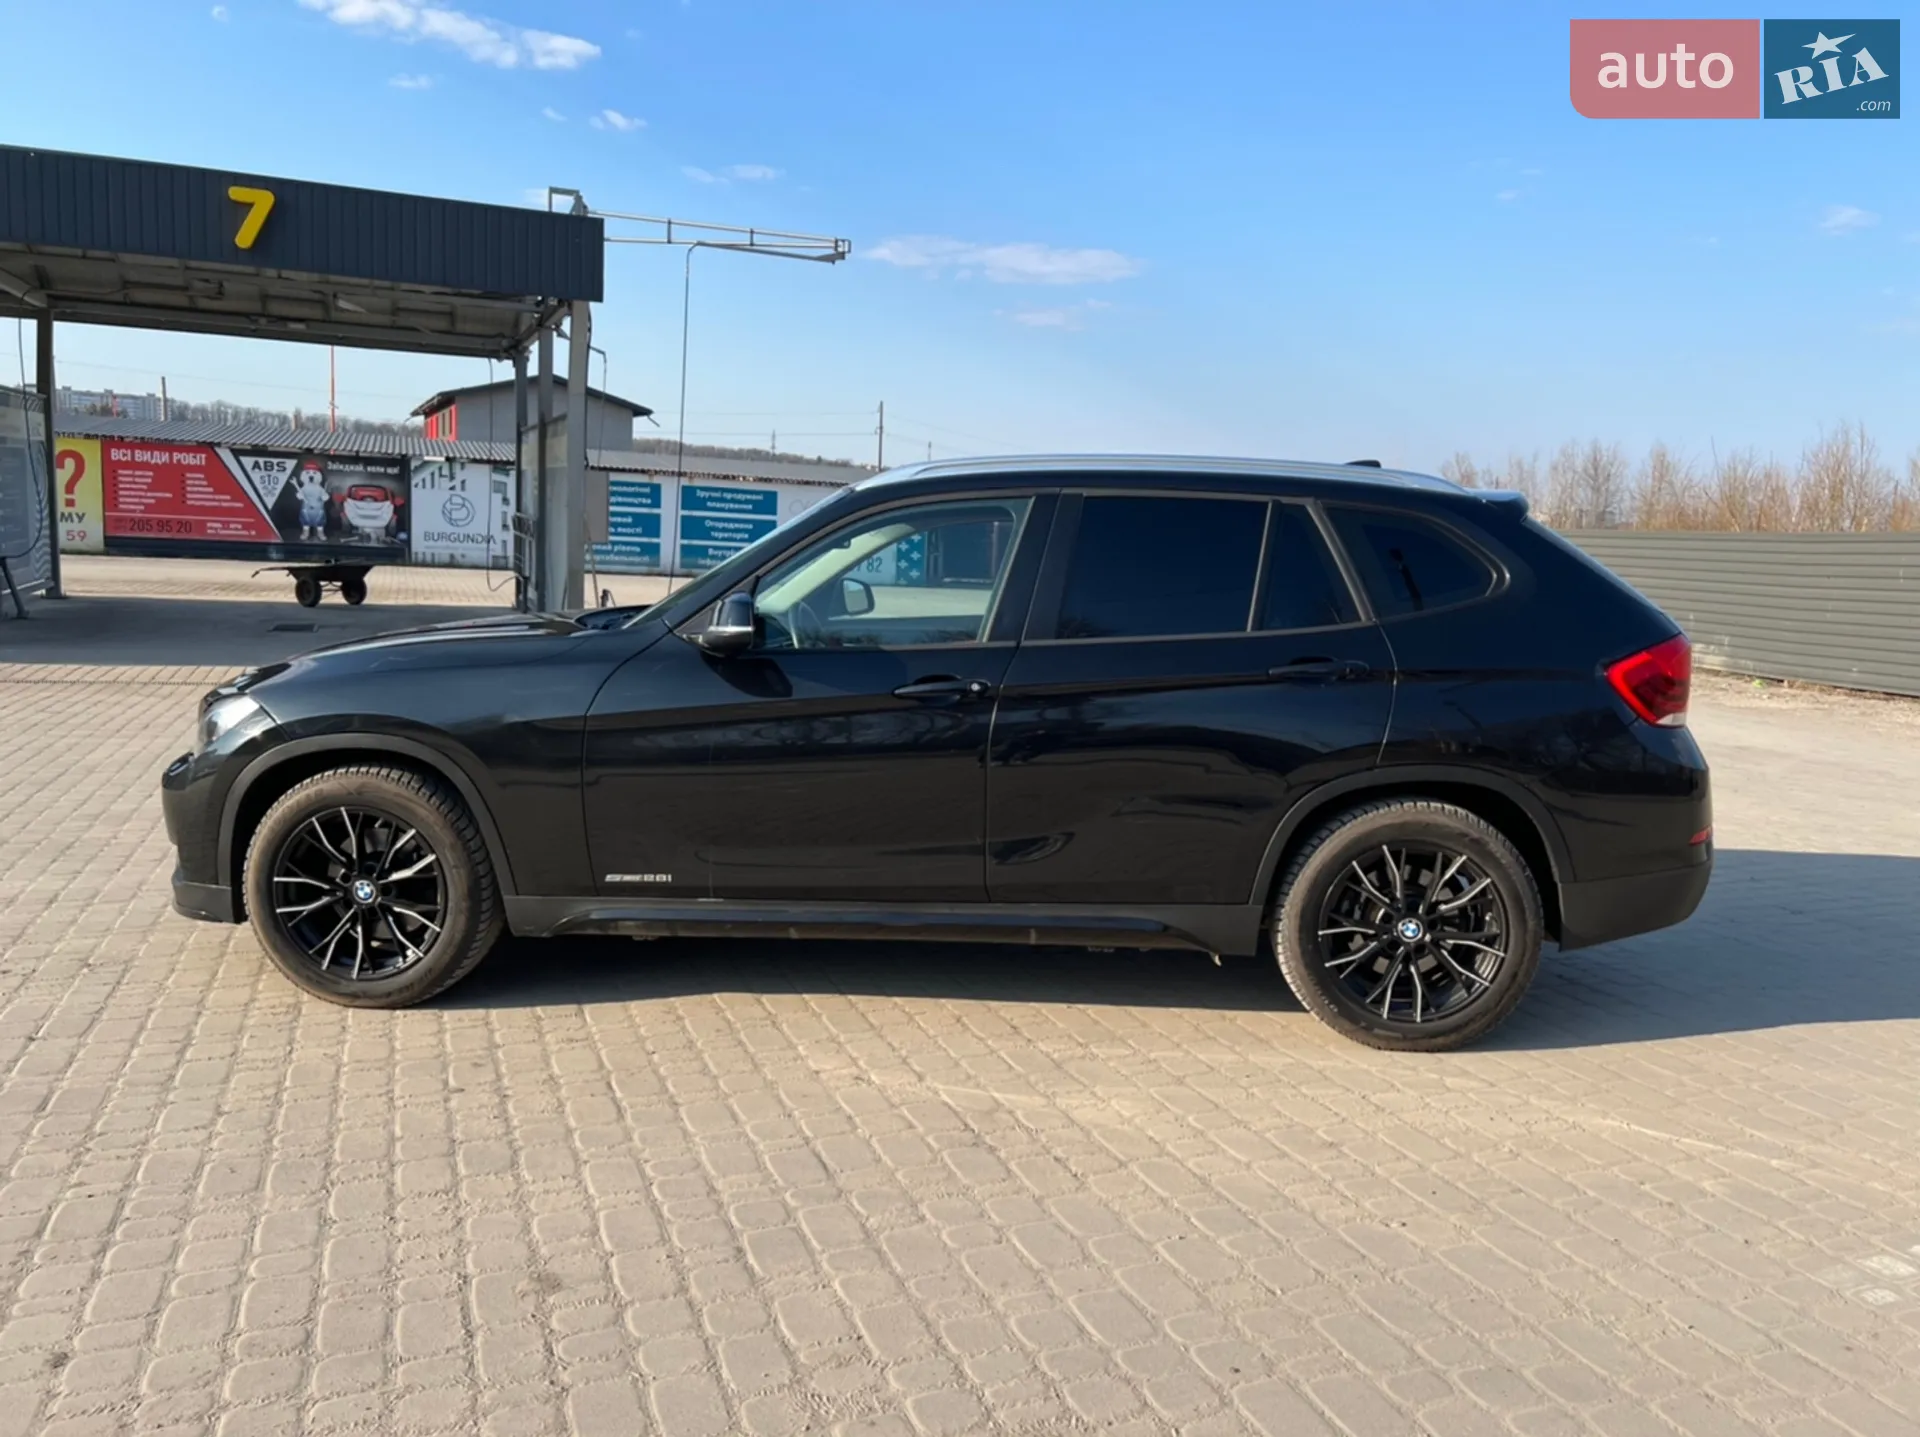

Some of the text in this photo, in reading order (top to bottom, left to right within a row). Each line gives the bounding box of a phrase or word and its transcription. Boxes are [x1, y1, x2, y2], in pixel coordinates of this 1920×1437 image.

[227, 185, 276, 250] 7
[110, 447, 207, 466] ВСІ ВИДИ РОБІТ
[251, 459, 288, 473] ABS
[706, 500, 753, 511] планування
[129, 518, 154, 533] 205
[156, 519, 172, 534] 95
[176, 520, 192, 534] 20
[65, 530, 87, 542] 59
[423, 530, 498, 546] BURGUNDIA
[710, 530, 750, 540] територія
[866, 556, 883, 573] 82
